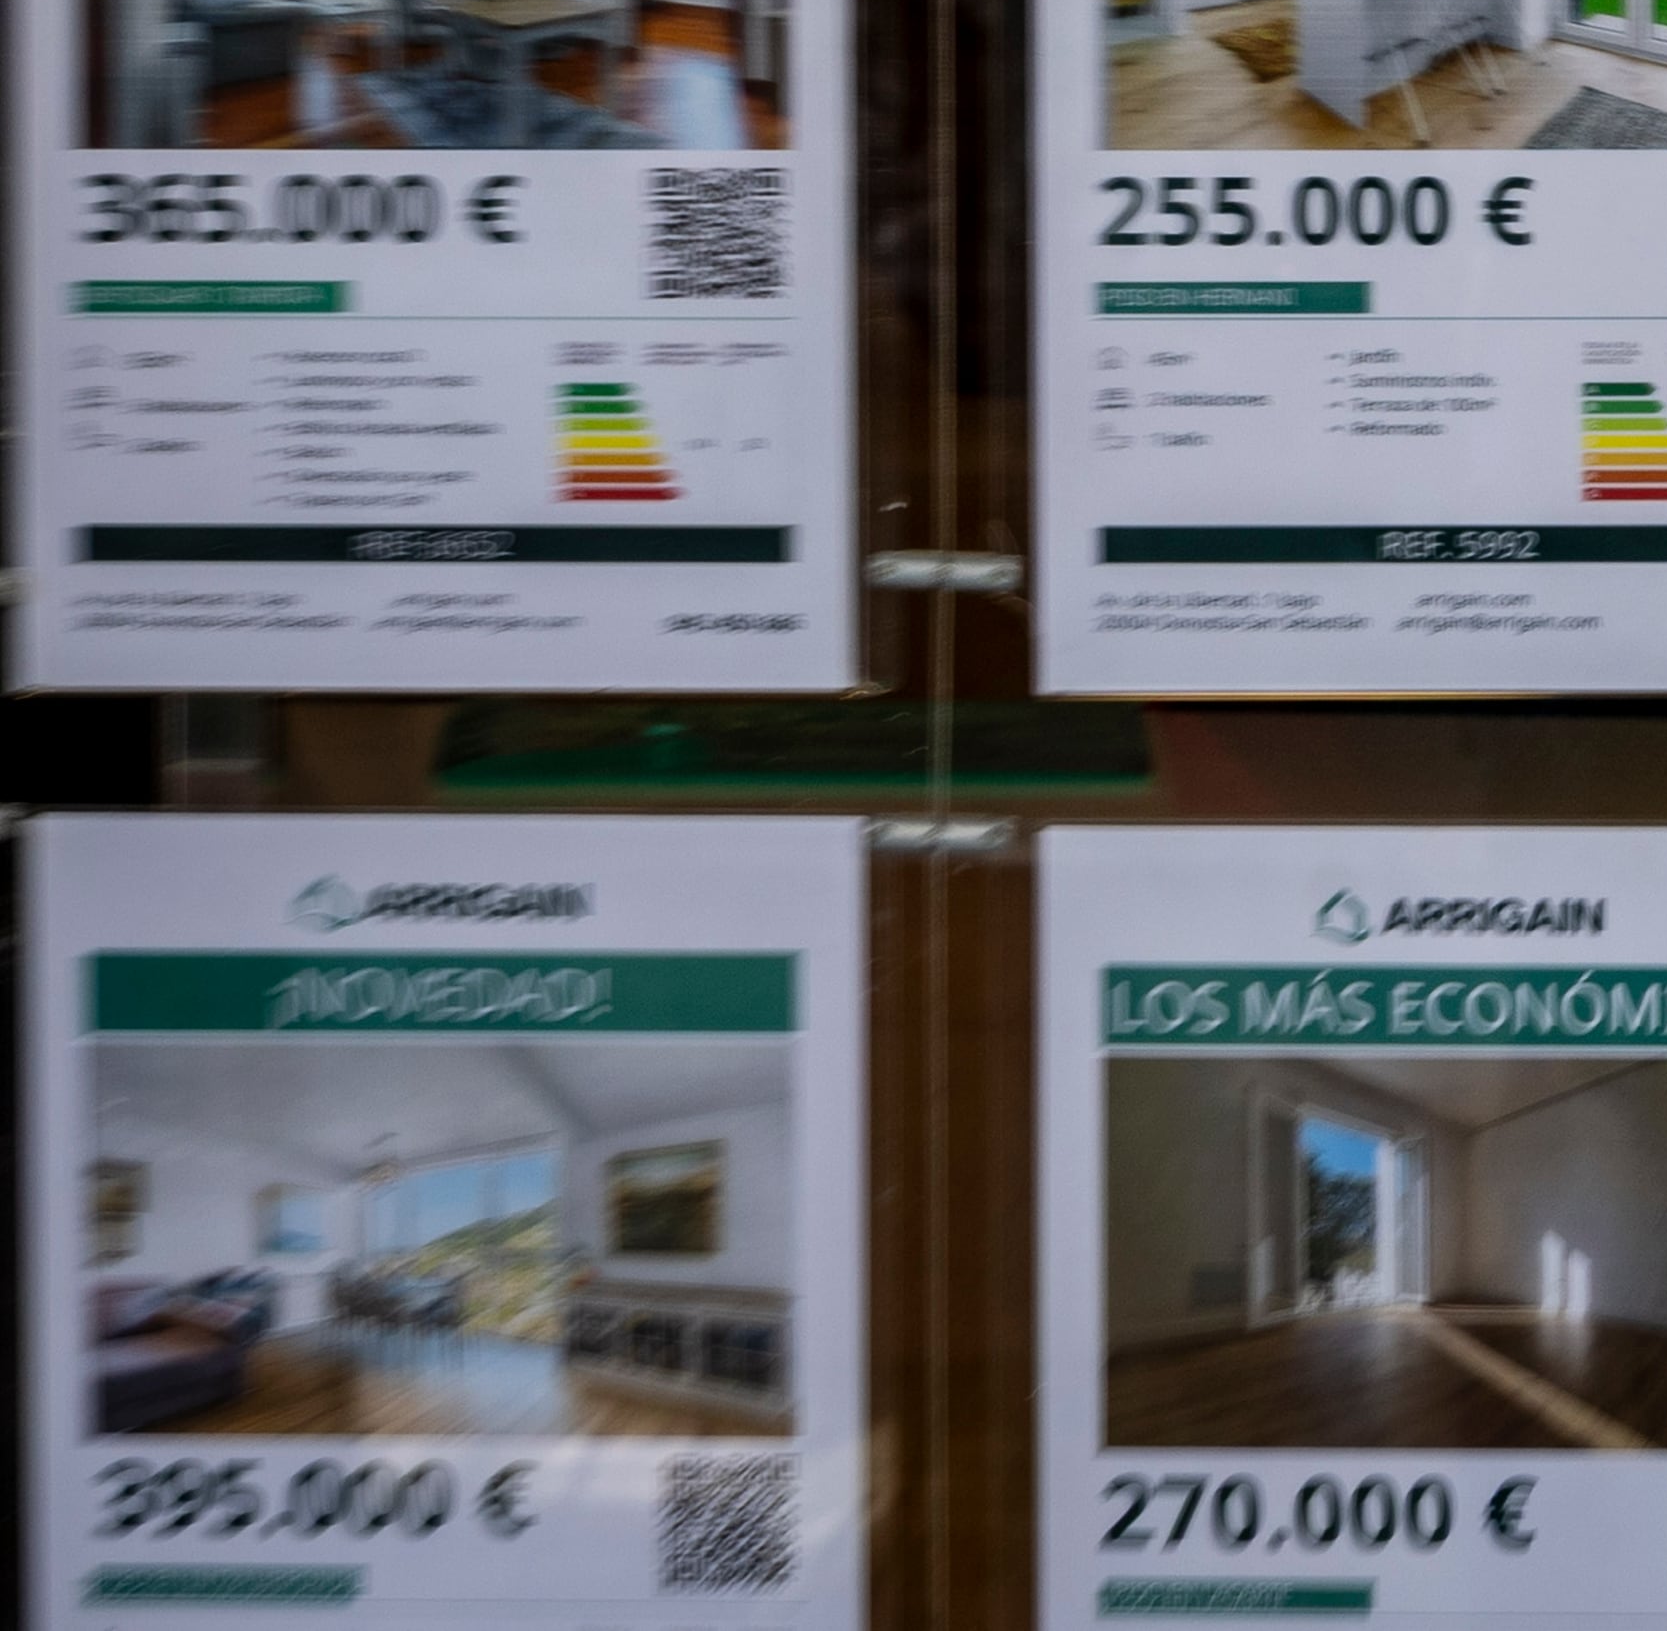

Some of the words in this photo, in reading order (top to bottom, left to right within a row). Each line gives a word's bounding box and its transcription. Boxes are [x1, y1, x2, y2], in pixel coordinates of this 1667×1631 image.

[77, 173, 447, 245] 365.000
[464, 173, 532, 245] €
[1096, 174, 1453, 247] 255.000
[1481, 174, 1535, 247] €
[1380, 896, 1609, 939] ARRIGAIN
[1107, 979, 1230, 1037] LOS
[1238, 968, 1377, 1037] MÁS
[1096, 1471, 1457, 1556] 270.000
[1481, 1472, 1539, 1553] €
